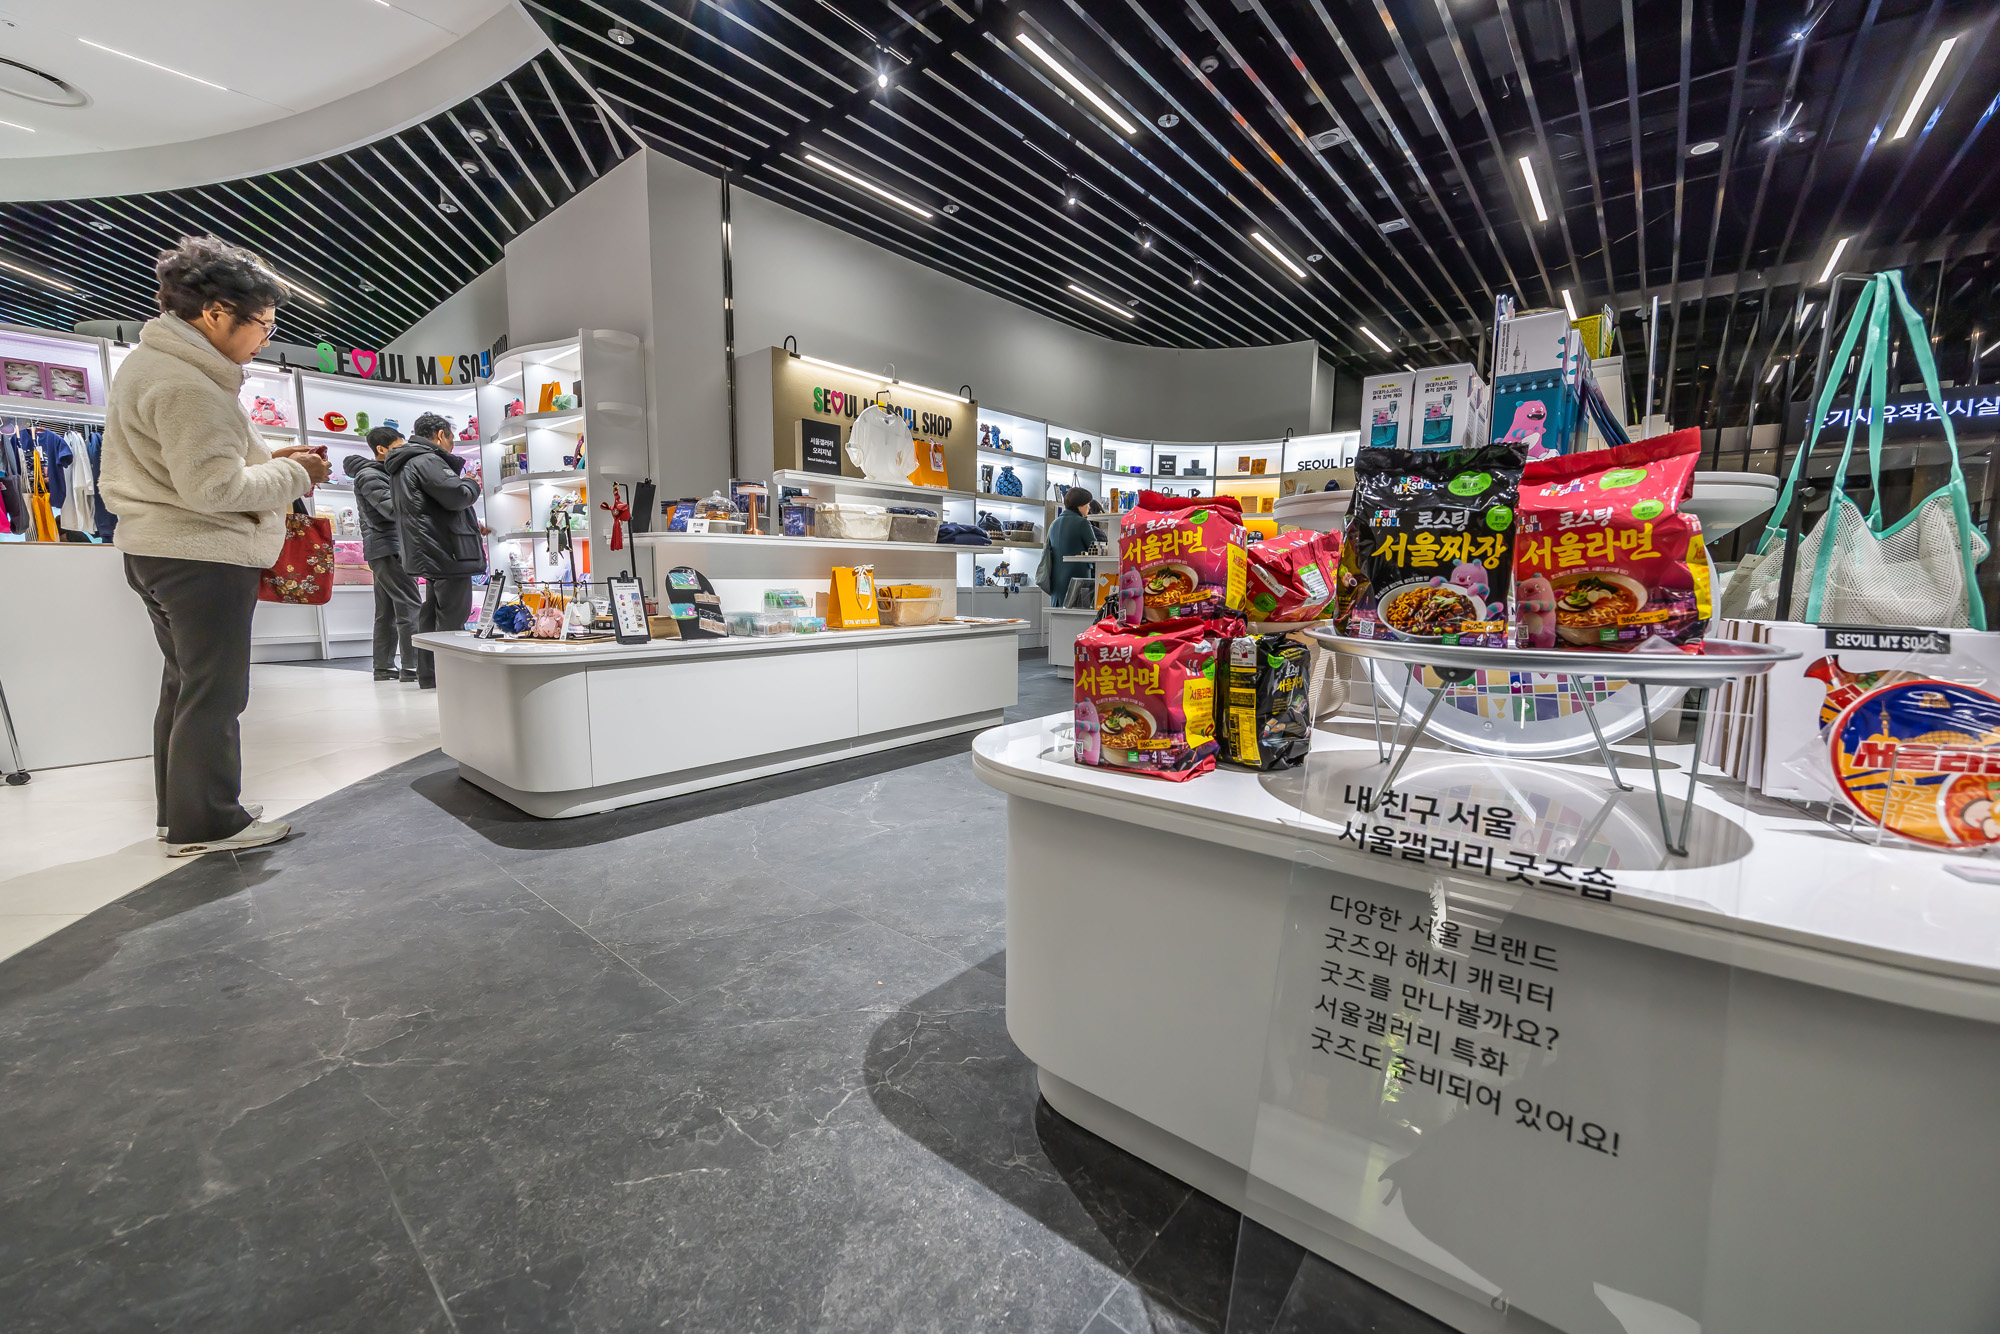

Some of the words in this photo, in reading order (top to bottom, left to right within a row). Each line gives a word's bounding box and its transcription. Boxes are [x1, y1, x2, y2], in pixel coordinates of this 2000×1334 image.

[317, 342, 411, 383] SEOUL
[814, 386, 859, 419] SEOUL
[922, 411, 952, 438] SHOP
[1806, 394, 2000, 430] 기시유적전시실
[810, 437, 834, 448] 서울갤러리
[812, 447, 832, 457] 오리지널
[1298, 458, 1338, 471] SEOUL
[1345, 456, 1357, 467] P
[1550, 478, 1581, 491] SEUL
[1145, 515, 1180, 534] 로스팅
[1415, 510, 1469, 531] 로스팅
[1558, 506, 1614, 531] 로스팅
[1121, 526, 1208, 567] 서울라면
[1371, 532, 1508, 570] 서울짜장
[1519, 522, 1662, 570] 서울라면
[1477, 634, 1483, 642] 4
[1640, 625, 1648, 636] 4
[1836, 633, 1877, 648] SEOUL
[1879, 635, 1901, 649] MY
[1099, 645, 1133, 664] 로스팅
[1076, 663, 1165, 696] 서울라면
[1152, 750, 1158, 760] 4
[1447, 803, 1517, 842] 서울
[1338, 822, 1494, 877] 서울갤러리
[1505, 850, 1617, 902] 굿즈숍
[1330, 895, 1402, 932] 다양한
[1409, 914, 1462, 949] 서울
[1471, 930, 1560, 973] 브랜드
[1324, 927, 1398, 968] 굿즈와
[1404, 949, 1457, 985] 해치
[1467, 965, 1555, 1013] 캐릭터
[1320, 959, 1393, 1001] 굿즈를
[1402, 982, 1560, 1051] 만나볼까요?
[1314, 993, 1440, 1055] 서울갤러리
[1450, 1036, 1510, 1078] 특화
[1310, 1026, 1383, 1071] 굿즈도
[1390, 1056, 1502, 1116] 준비되어
[1514, 1096, 1621, 1158] 있어요!
